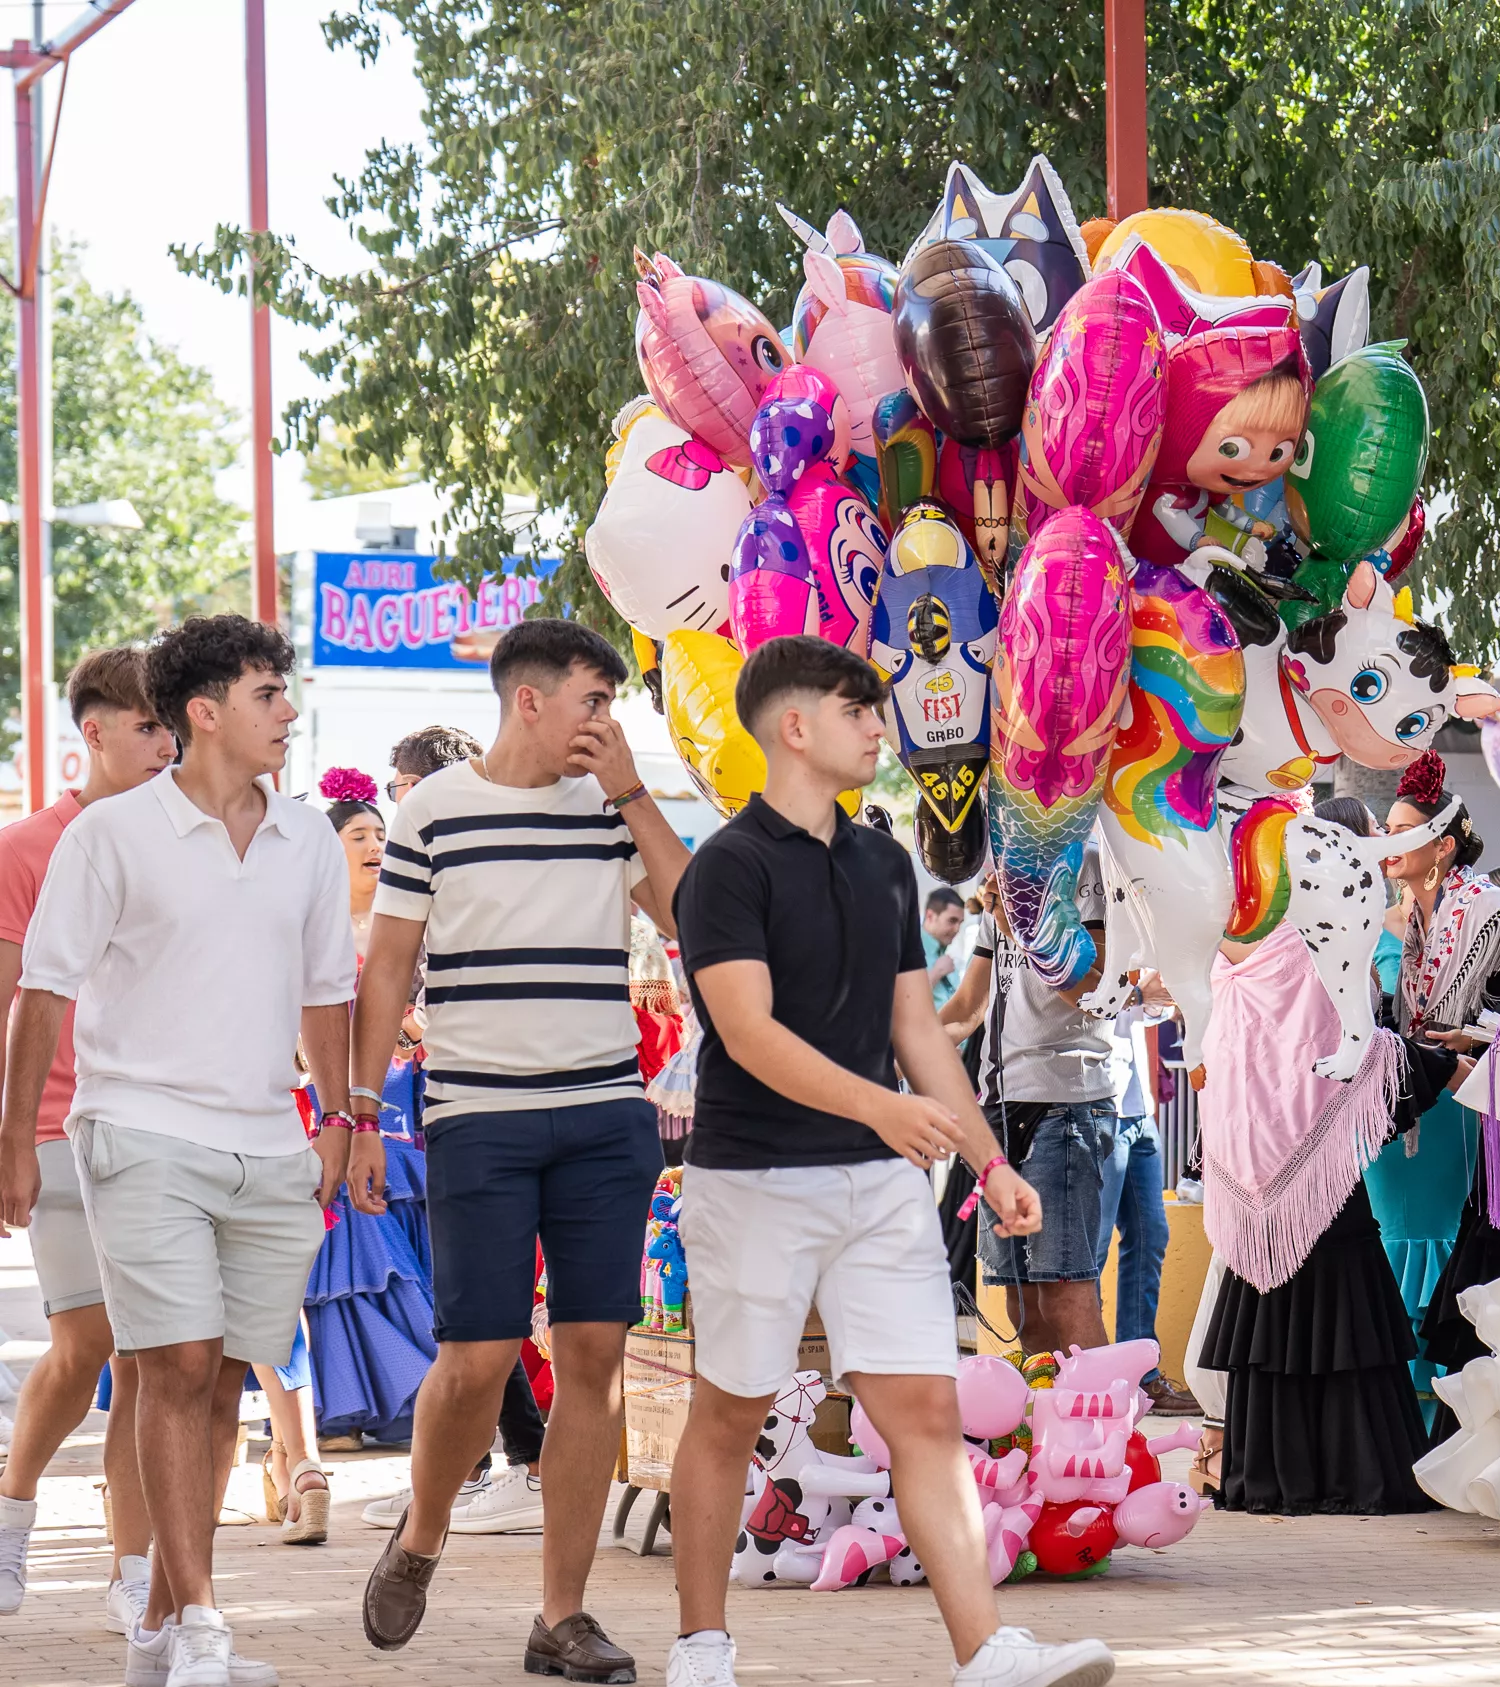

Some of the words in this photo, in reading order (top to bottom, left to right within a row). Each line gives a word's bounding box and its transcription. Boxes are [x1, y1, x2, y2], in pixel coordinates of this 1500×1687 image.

[343, 560, 417, 590] ADRI
[321, 573, 539, 652] BAGUETERI
[925, 671, 954, 694] 45
[923, 693, 961, 722] FEST
[921, 772, 949, 800] 45
[951, 765, 975, 801] 45
